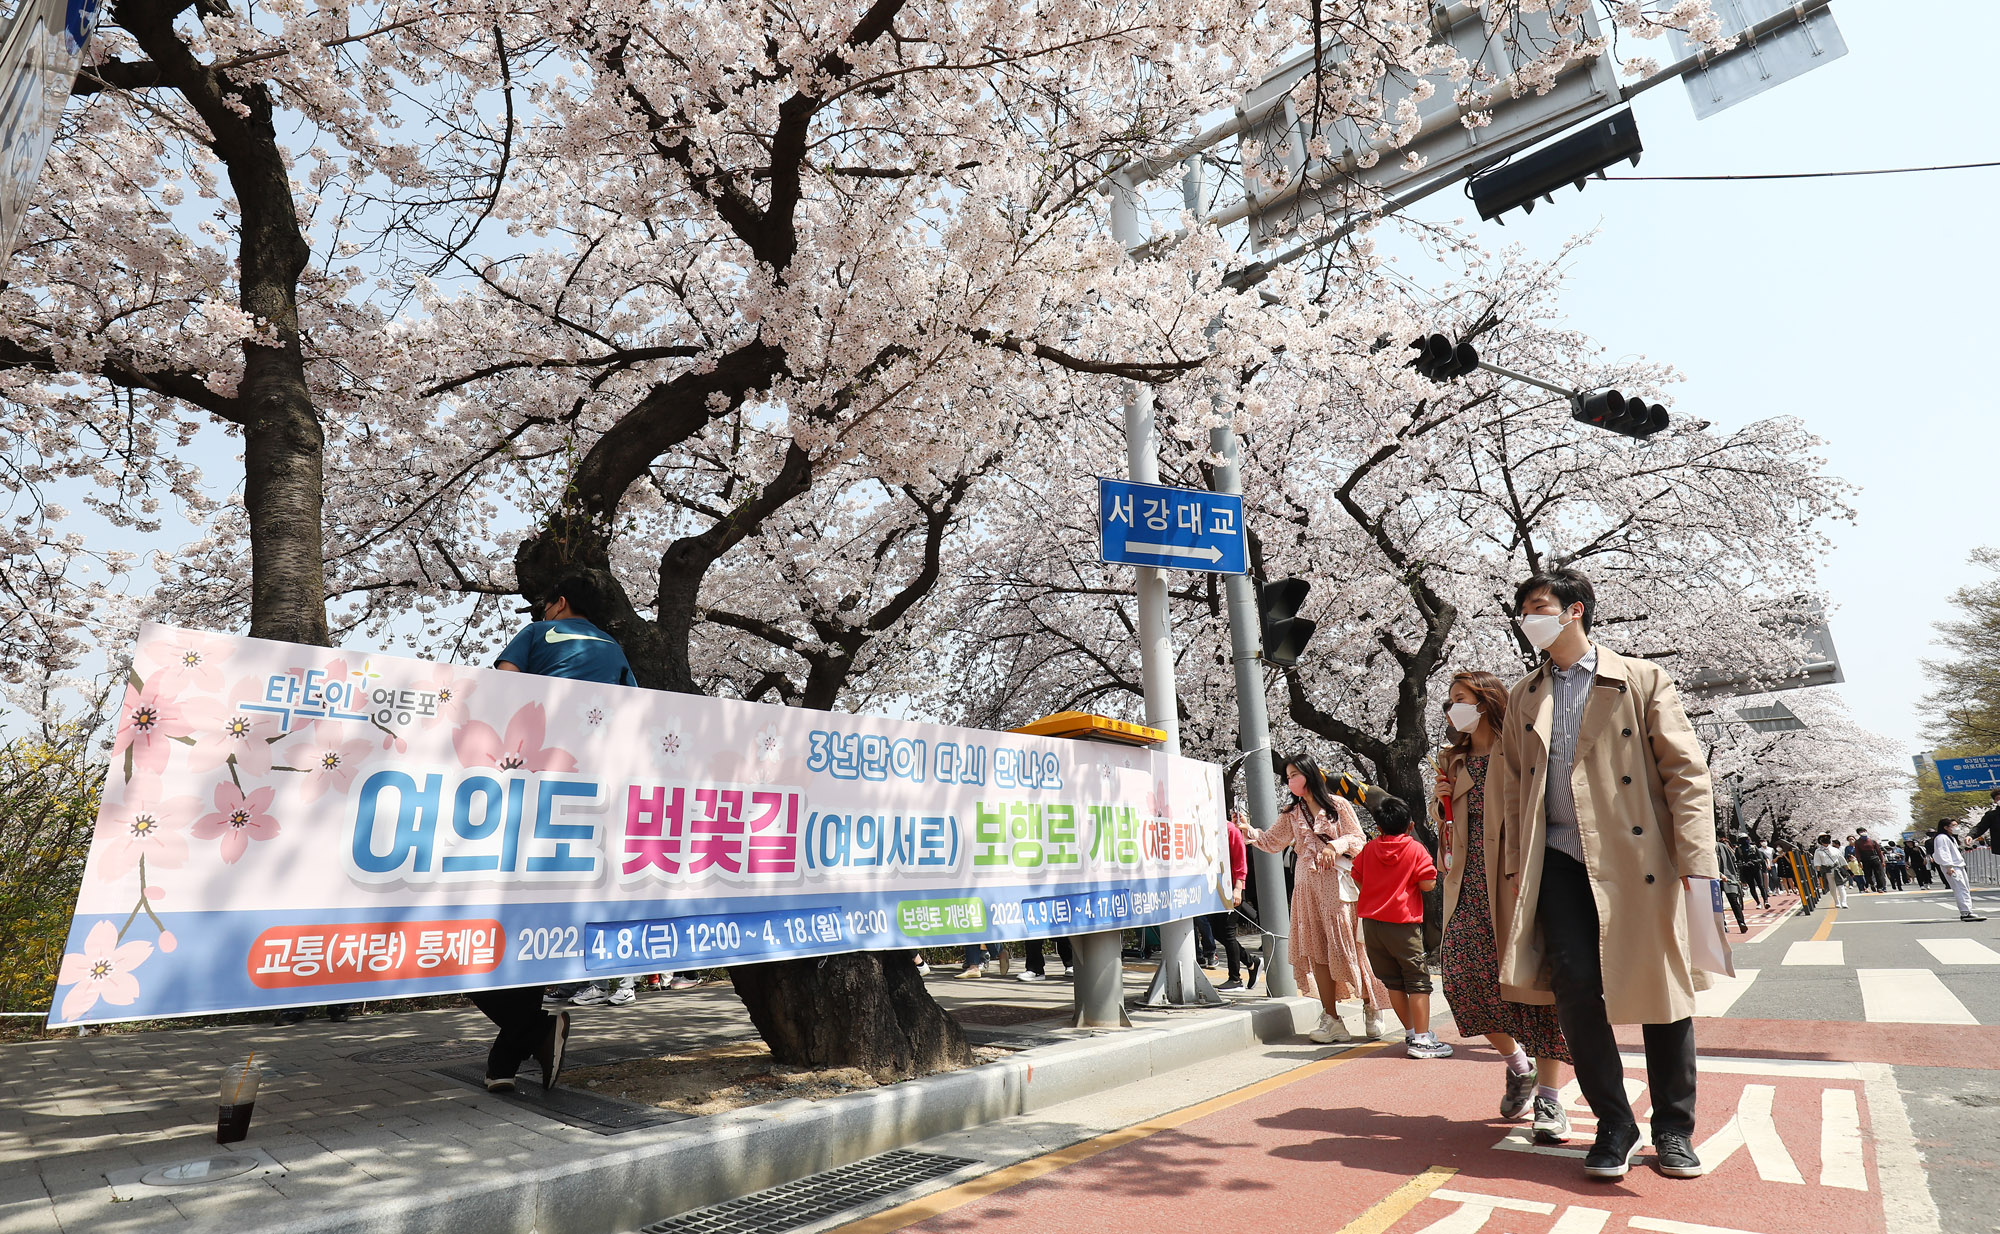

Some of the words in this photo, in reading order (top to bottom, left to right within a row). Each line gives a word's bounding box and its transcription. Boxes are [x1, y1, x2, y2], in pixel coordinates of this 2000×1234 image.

[1108, 494, 1237, 535] 서강대교
[239, 669, 369, 732] 탁트인
[372, 688, 436, 726] 영등포
[807, 730, 926, 783] 3년만에
[934, 742, 985, 787] 다시
[994, 748, 1062, 790] 만나요
[352, 771, 598, 874] 여의도
[974, 800, 1079, 867] 보행로
[686, 921, 741, 952] 12:00
[845, 909, 888, 935] 12:00
[903, 905, 944, 931] 보행로
[944, 902, 983, 929] 개방일
[256, 930, 407, 976] 교통(차량)
[416, 928, 496, 968] 통제일
